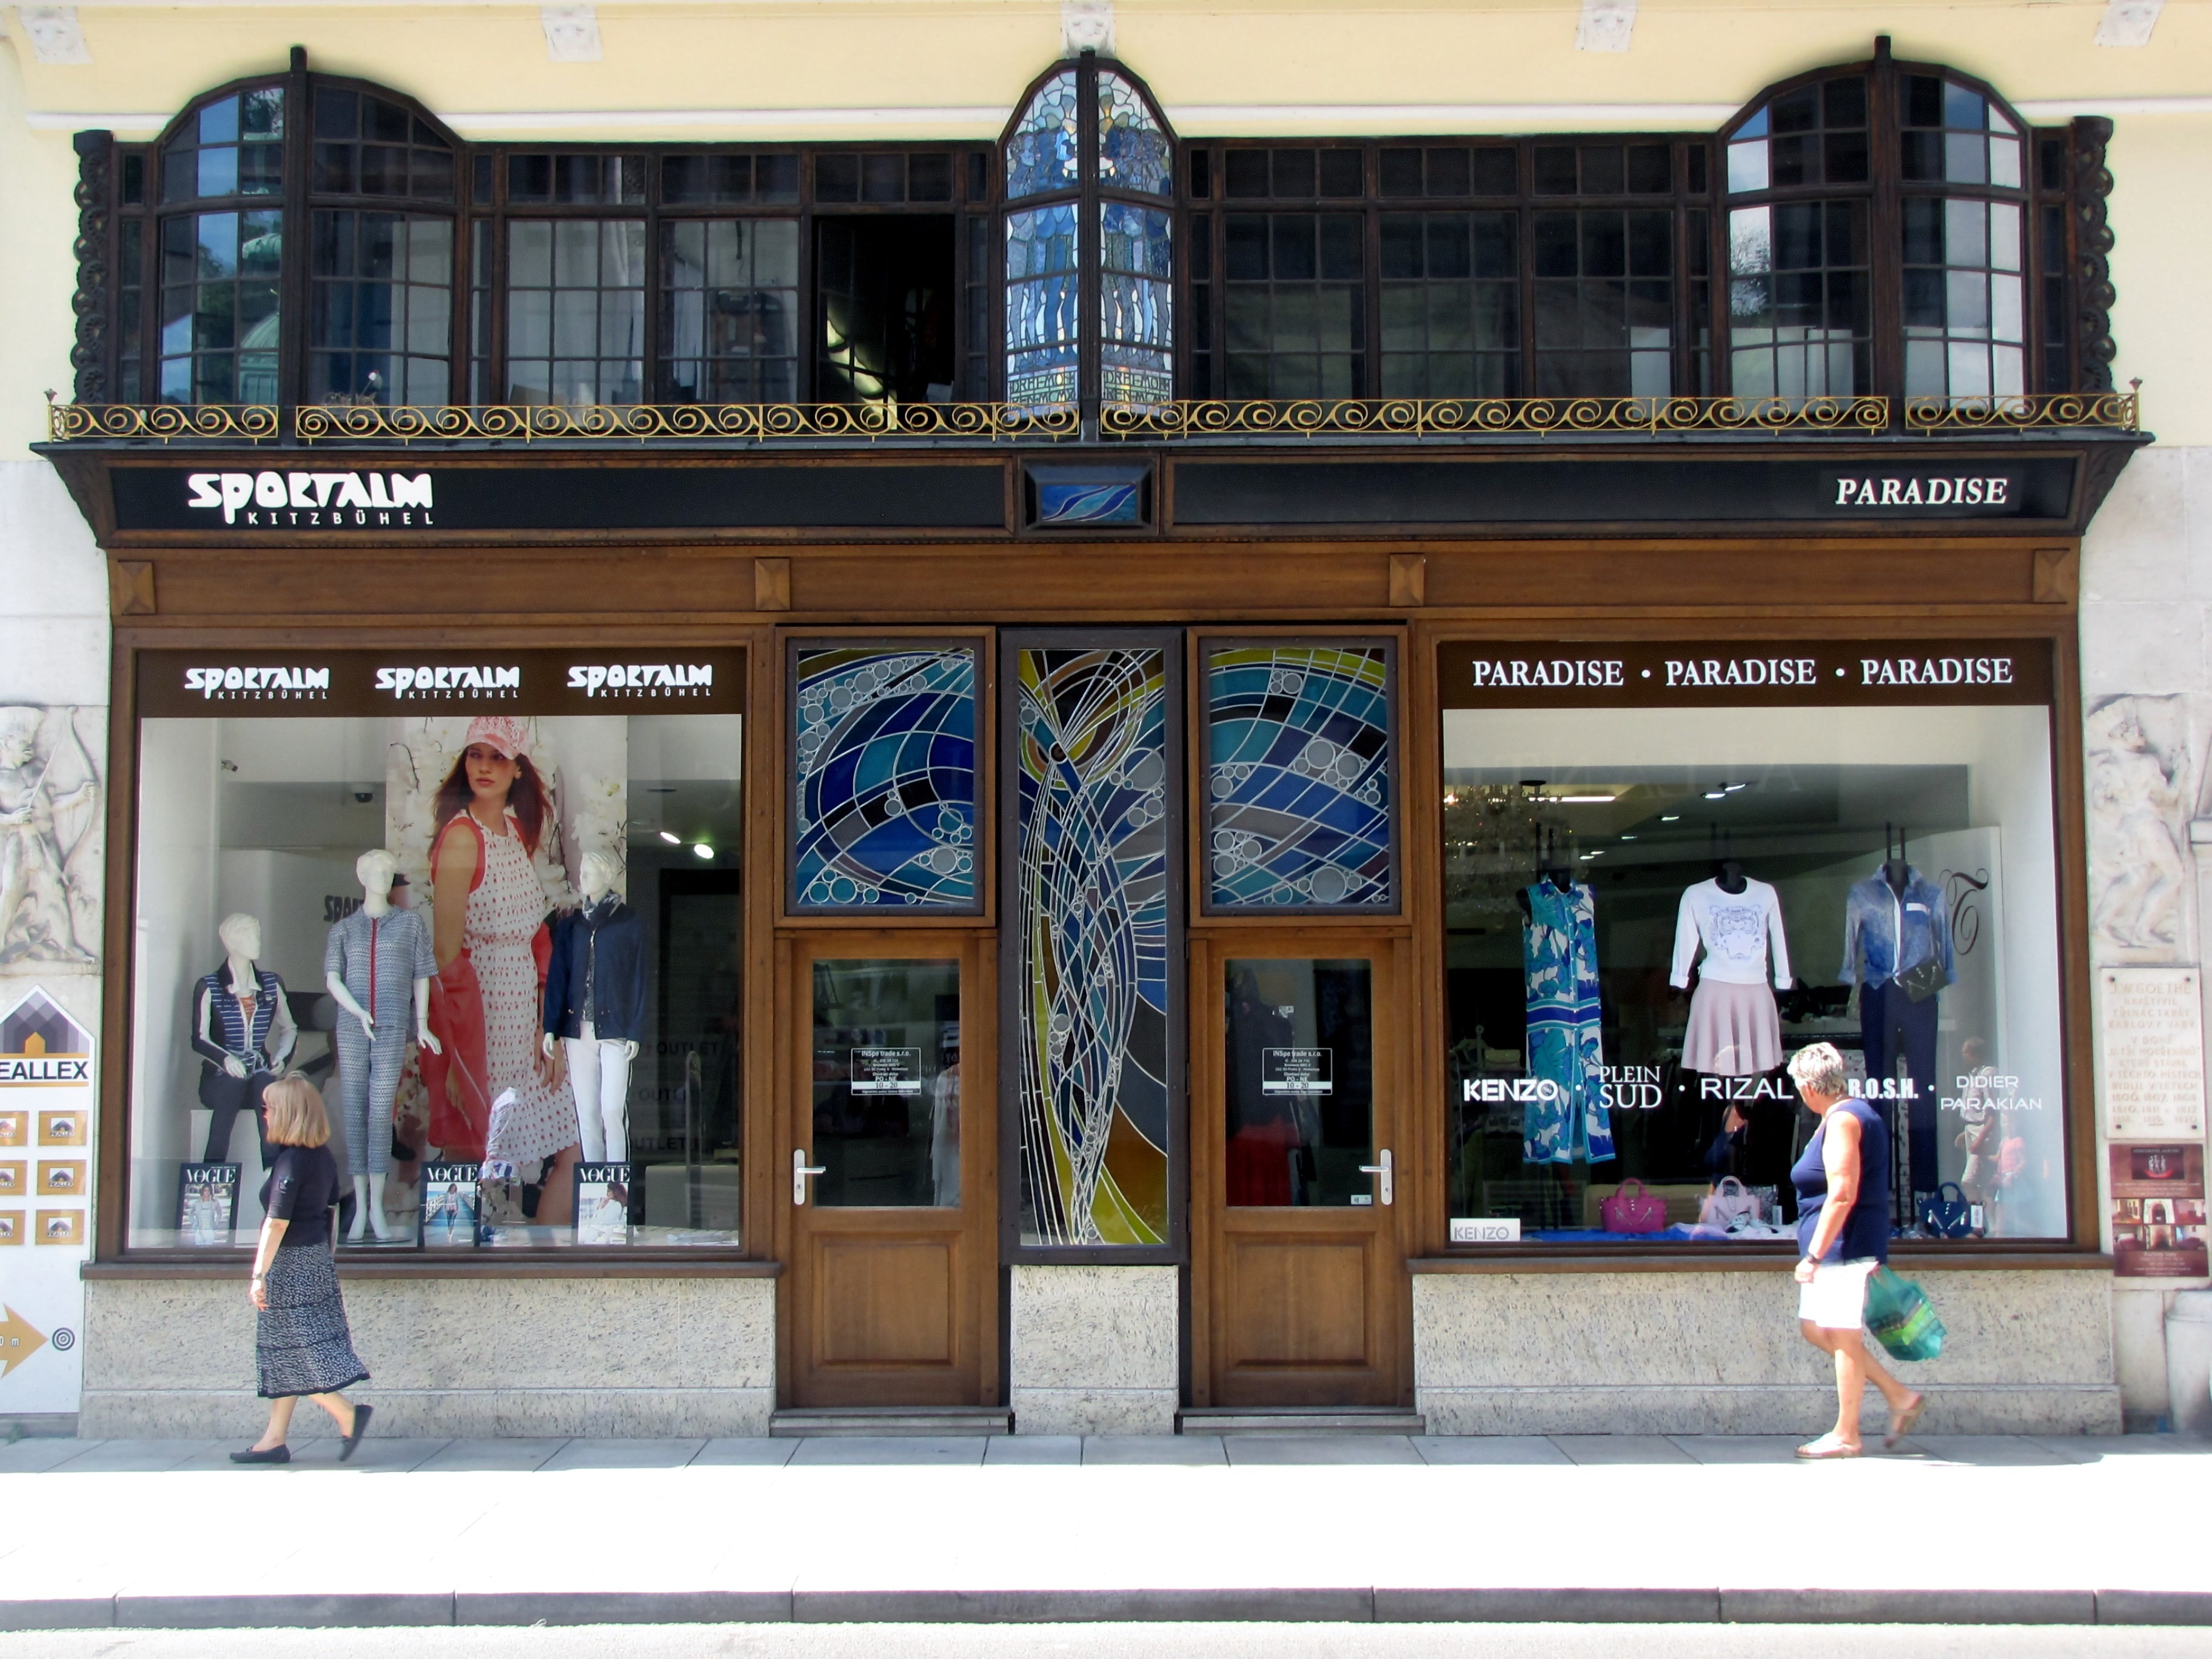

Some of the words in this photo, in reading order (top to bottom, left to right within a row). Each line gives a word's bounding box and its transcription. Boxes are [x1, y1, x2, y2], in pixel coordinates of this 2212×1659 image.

[189, 472, 433, 524] SPORTALM
[1836, 478, 2007, 504] PARADISE
[248, 509, 434, 525] KITZBÜHEL
[1473, 660, 1624, 686] PARADISE
[1665, 659, 1816, 686] PARADISE
[1861, 659, 2012, 685] PARADISE
[184, 667, 329, 699] SPORTALM
[375, 666, 520, 699] SPORTALM
[568, 665, 712, 697] SPORTALM
[218, 689, 327, 699] KITZBÜHEL
[409, 688, 518, 699] KITZBÜHEL
[601, 686, 711, 697] KITZBÜHEL
[1599, 1065, 1661, 1082] PLEIN
[1956, 1075, 2019, 1088] DIDIER
[1464, 1079, 1558, 1102] KENZO
[1600, 1084, 1662, 1108] SUD
[1701, 1078, 1794, 1099] RIZAL
[1940, 1097, 2042, 1111] PARAKIAN
[187, 1168, 236, 1184] VOGUE
[427, 1167, 477, 1182] VOGUE
[580, 1167, 631, 1182] VOGUE
[1453, 1227, 1510, 1241] KENZO
[11, 1337, 19, 1347] m
